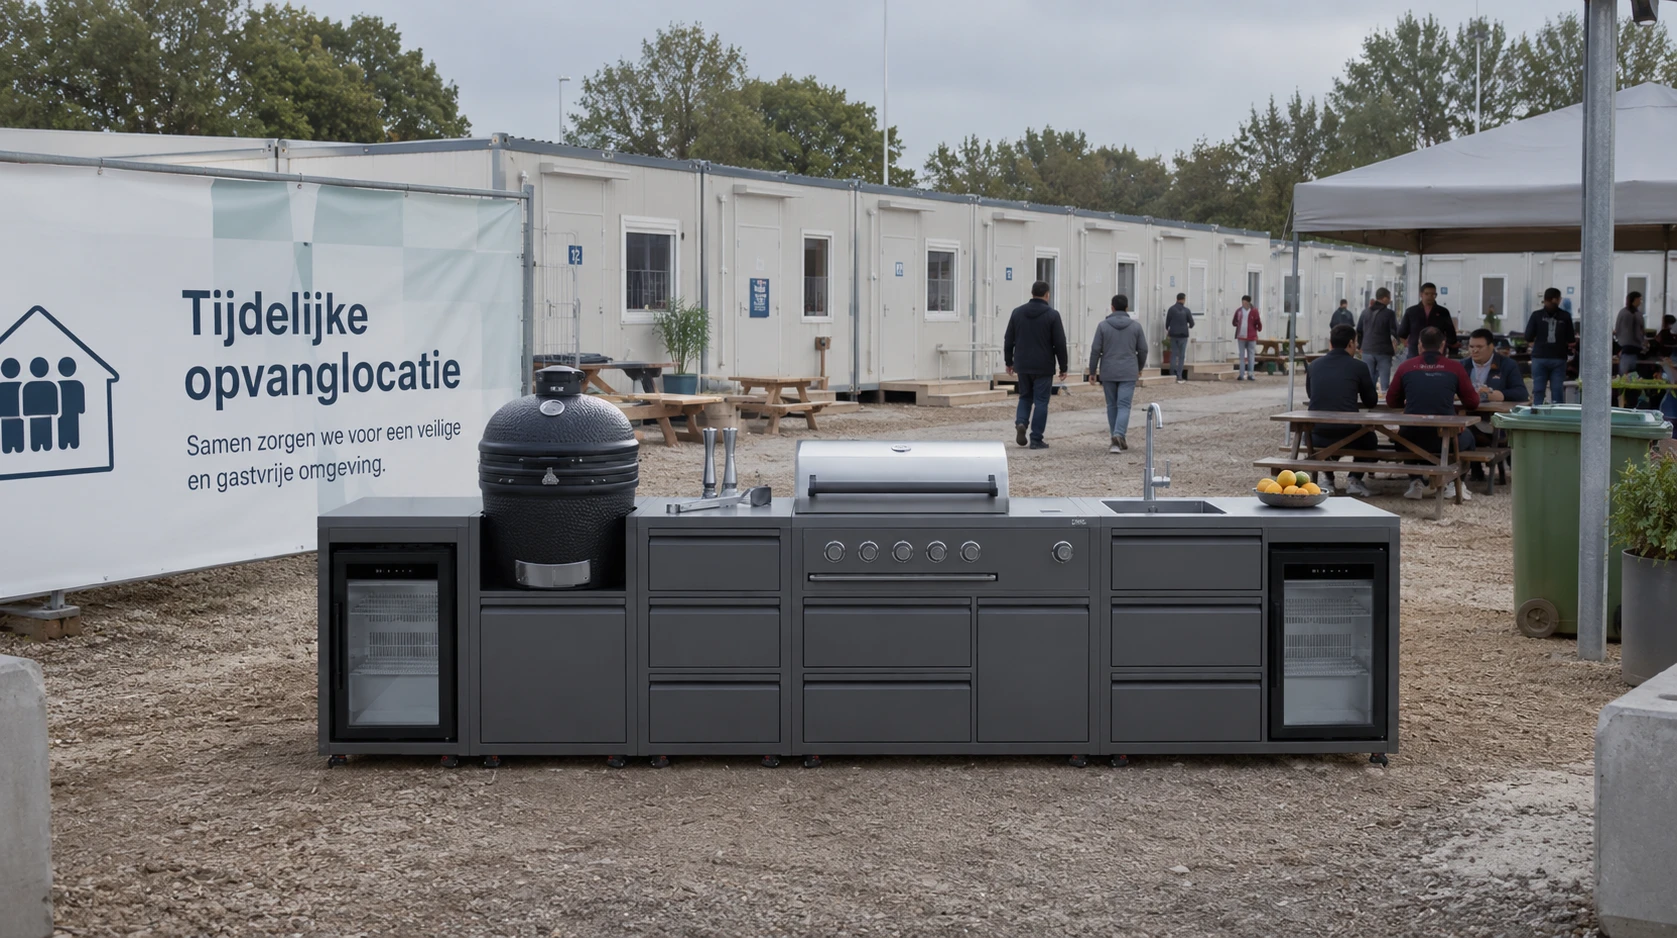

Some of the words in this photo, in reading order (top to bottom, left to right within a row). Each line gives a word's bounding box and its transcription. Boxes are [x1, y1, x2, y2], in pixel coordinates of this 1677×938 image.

[571, 249, 580, 262] 12
[182, 289, 368, 347] Tijdelijke
[184, 349, 461, 411] opvanglocatie
[186, 433, 252, 456] Samen
[257, 431, 316, 455] zorgen
[320, 429, 344, 446] we
[348, 426, 382, 444] voor
[386, 424, 413, 442] een
[417, 418, 461, 443] veilige
[187, 470, 211, 491] en
[216, 462, 294, 493] gastvrije
[298, 455, 386, 482] omgeving.
